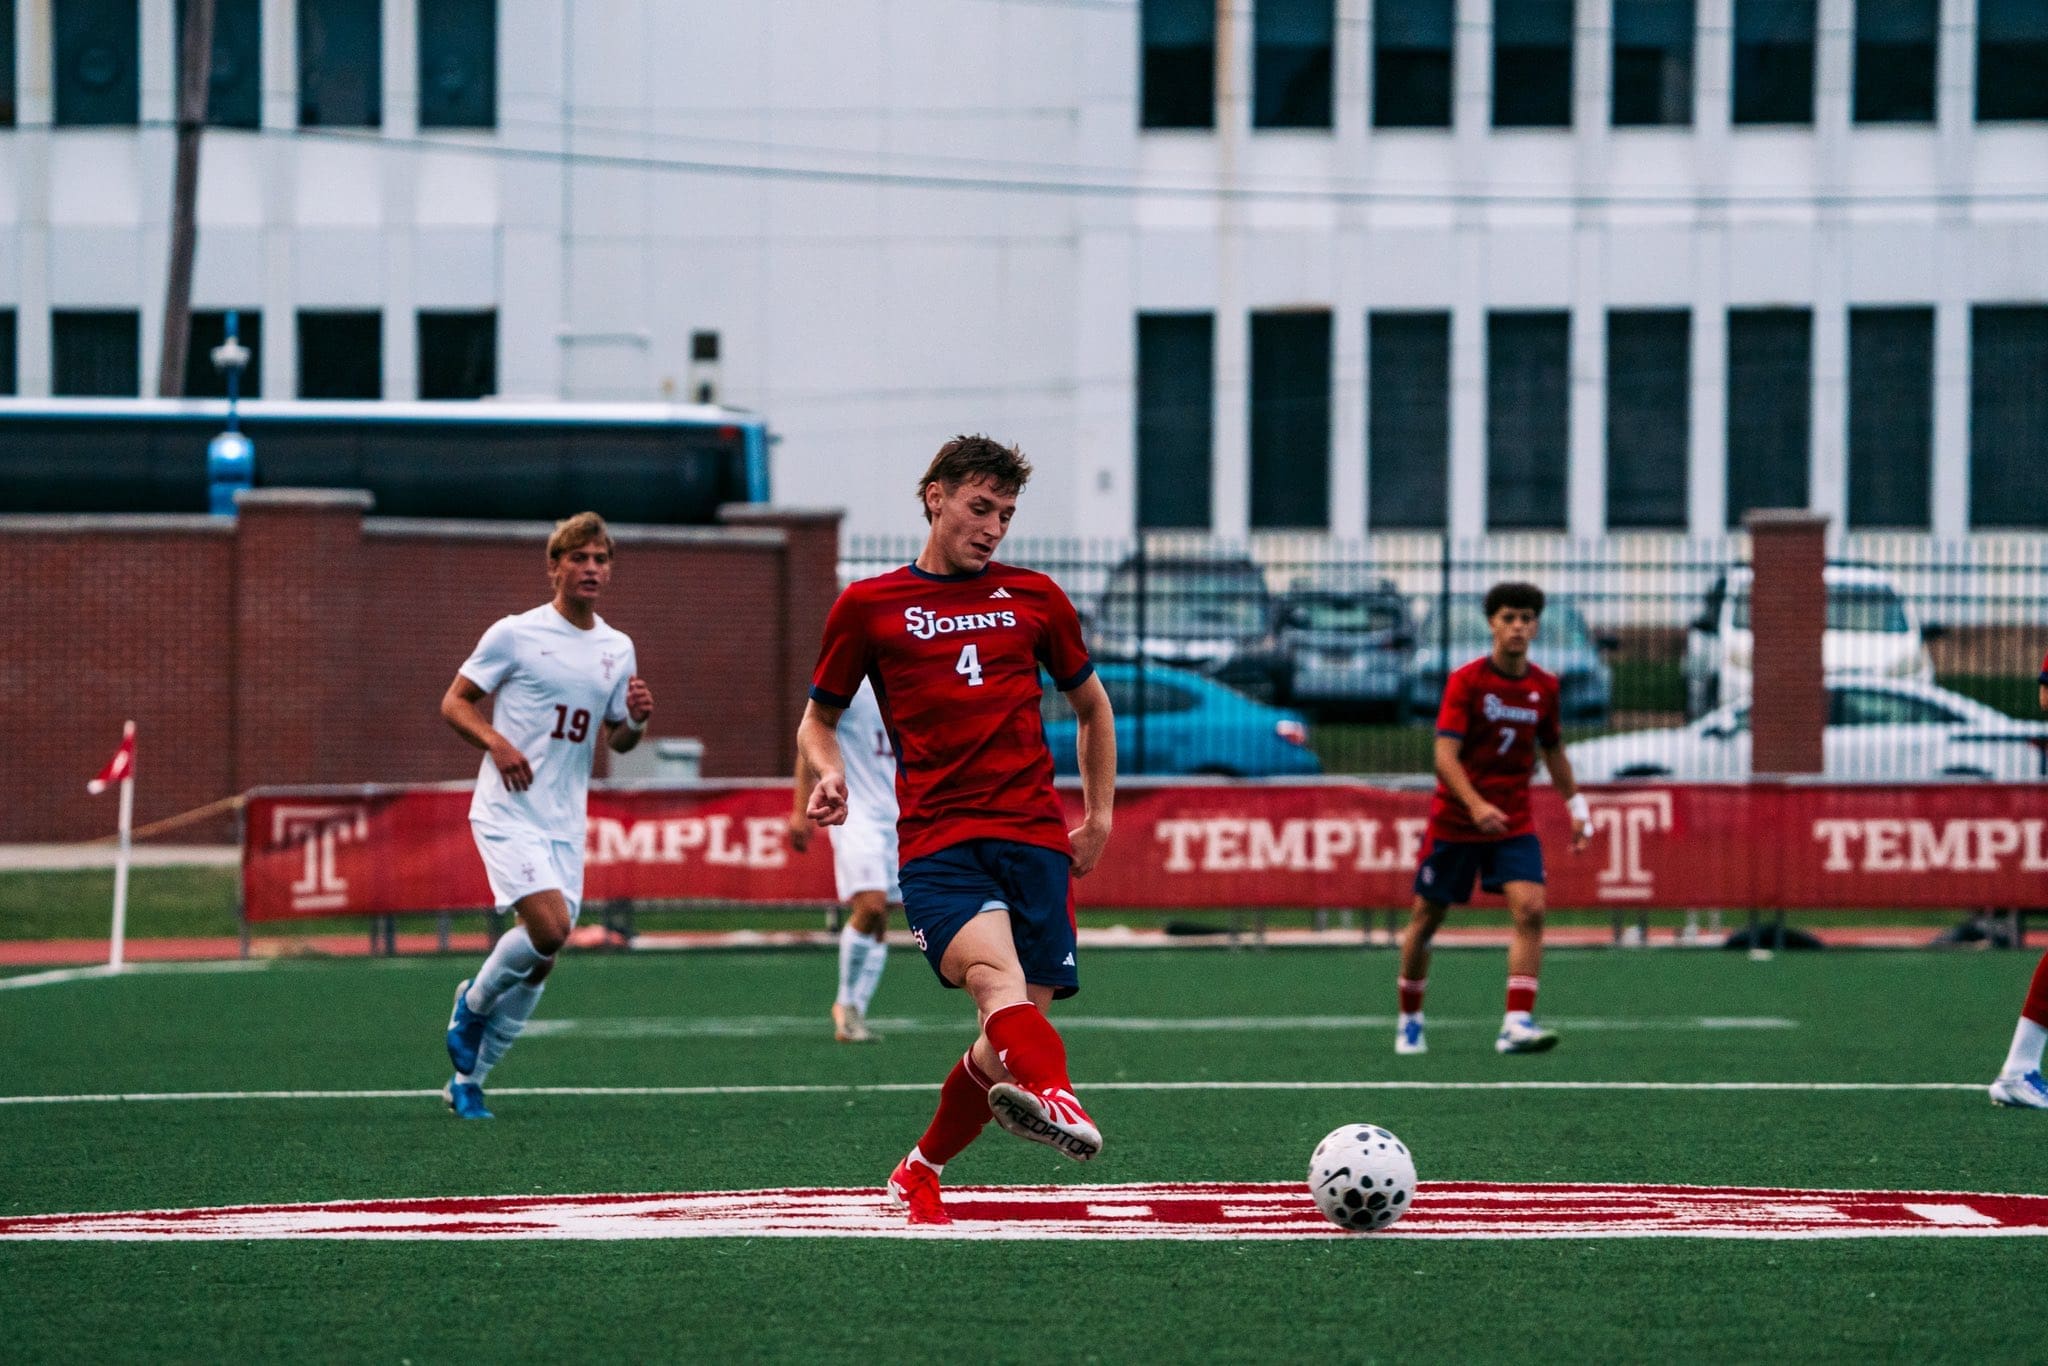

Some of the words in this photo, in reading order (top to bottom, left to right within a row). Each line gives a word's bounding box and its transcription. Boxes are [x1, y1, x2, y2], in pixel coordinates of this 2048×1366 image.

[955, 643, 984, 687] 4
[550, 703, 591, 743] 19
[1498, 727, 1516, 755] 7
[993, 1094, 1097, 1160] PREDATOR
